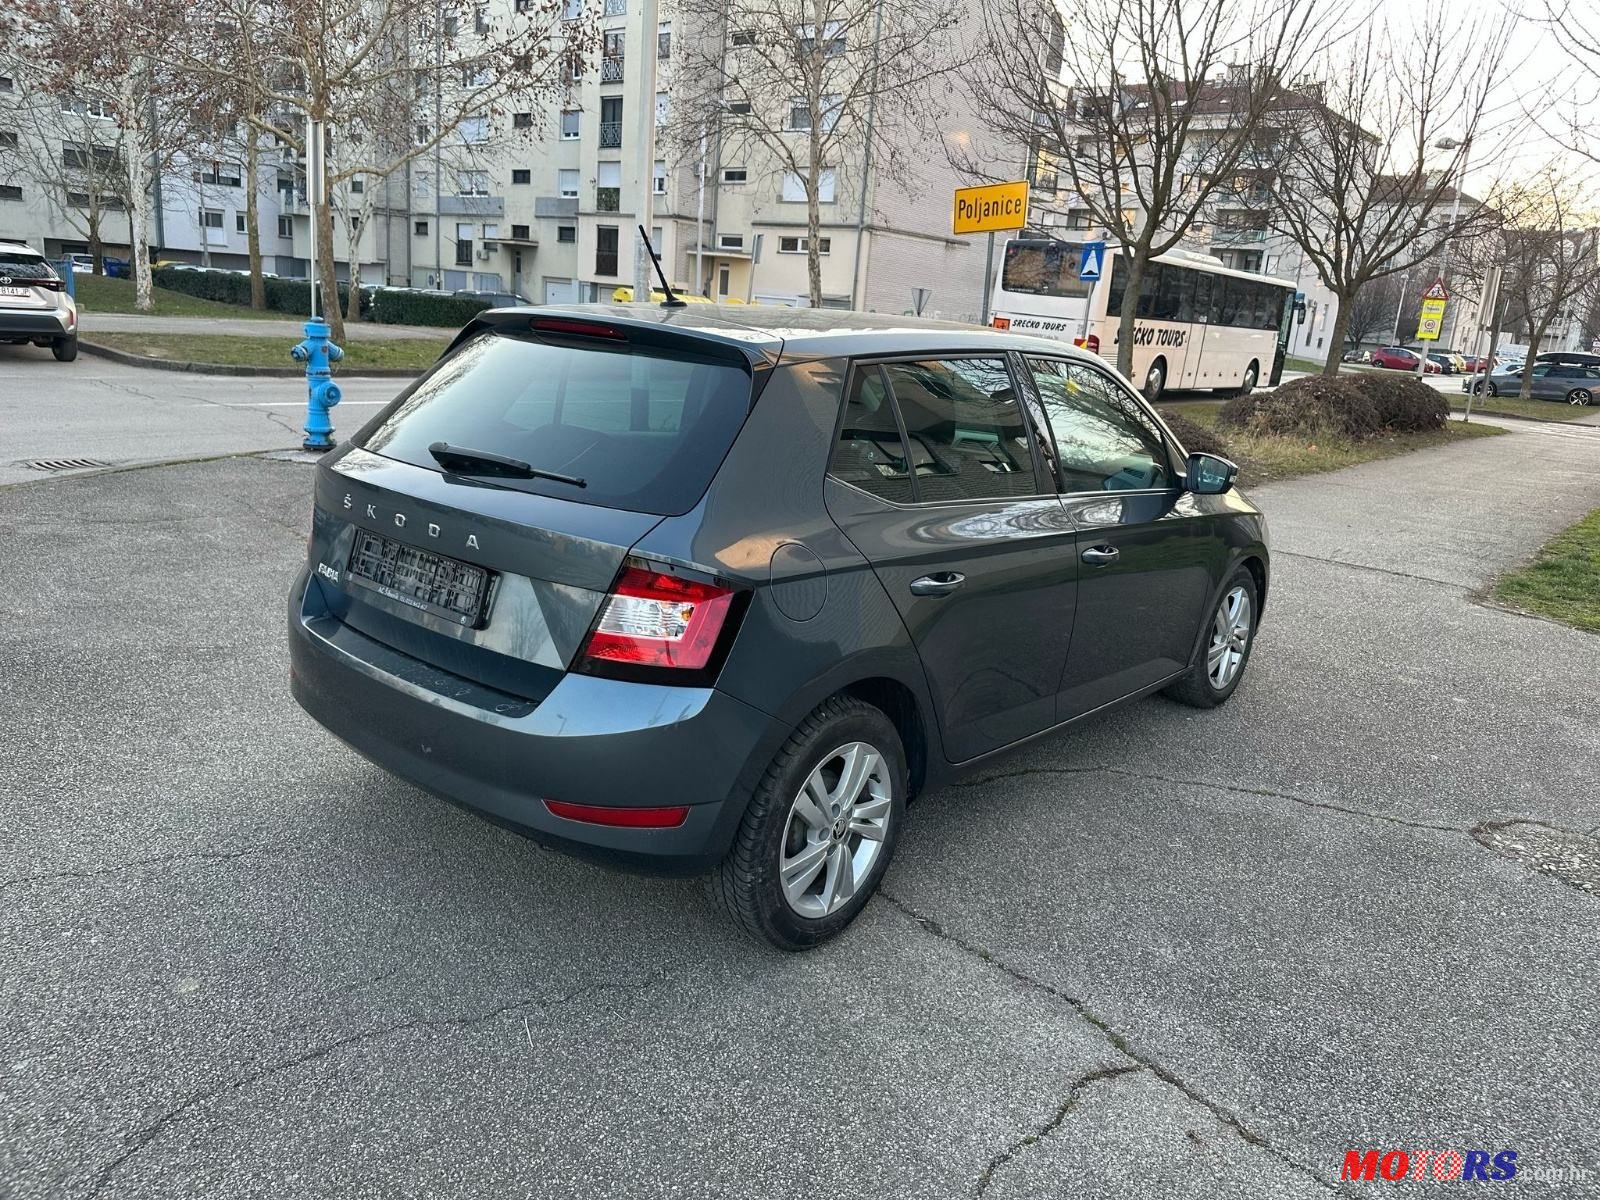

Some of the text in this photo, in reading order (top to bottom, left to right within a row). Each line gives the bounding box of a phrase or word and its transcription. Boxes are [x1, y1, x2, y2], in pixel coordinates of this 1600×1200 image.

[958, 194, 1022, 224] Poljanice
[1041, 321, 1067, 331] TOURS
[1155, 328, 1187, 348] TOURS
[343, 493, 480, 550] ŠKODA
[318, 562, 339, 583] FABIA
